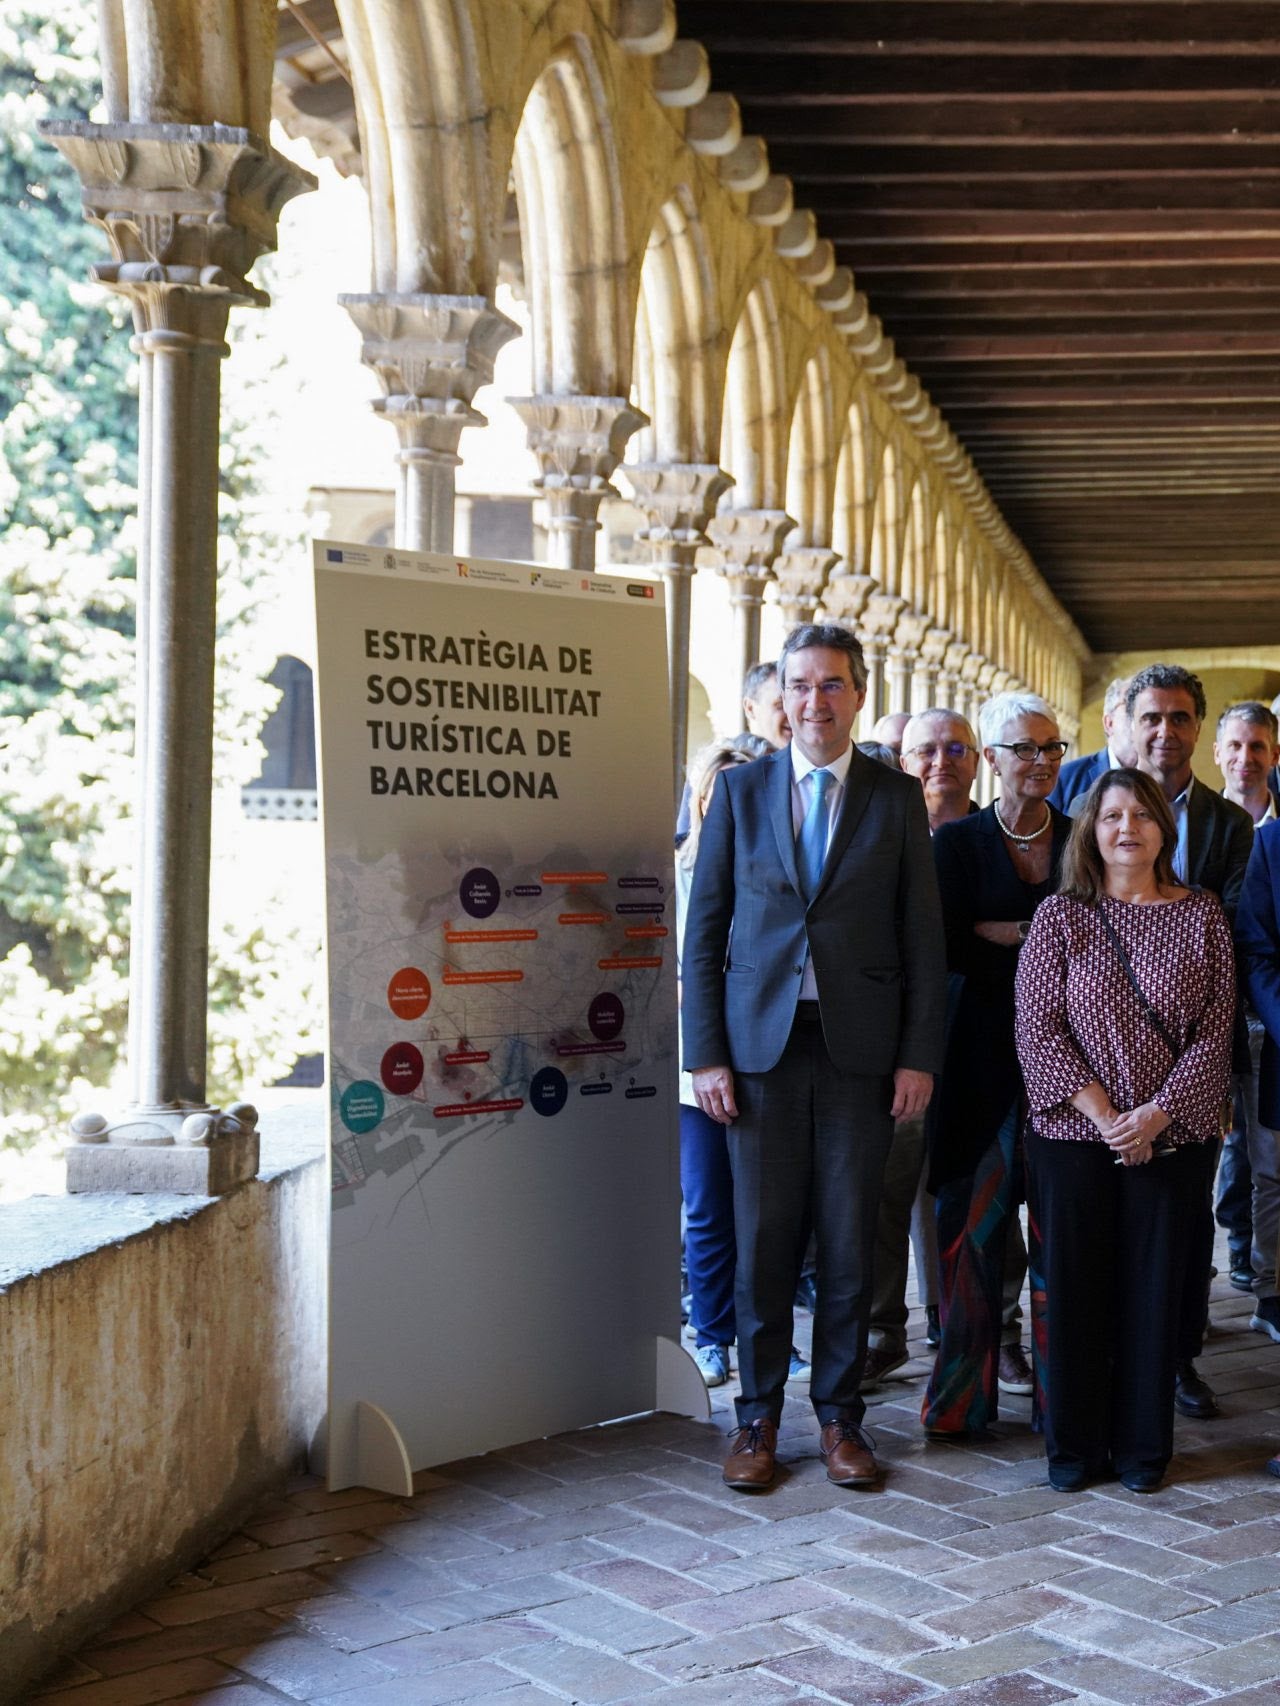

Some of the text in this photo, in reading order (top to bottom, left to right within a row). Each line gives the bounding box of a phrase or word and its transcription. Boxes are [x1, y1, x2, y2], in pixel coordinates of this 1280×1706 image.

[364, 629, 593, 676] ESTRATÈGIA DE
[366, 674, 602, 718] SOSTENIBILITAT
[366, 714, 572, 758] TURÍSTICA DE
[370, 765, 559, 800] BARCELONA
